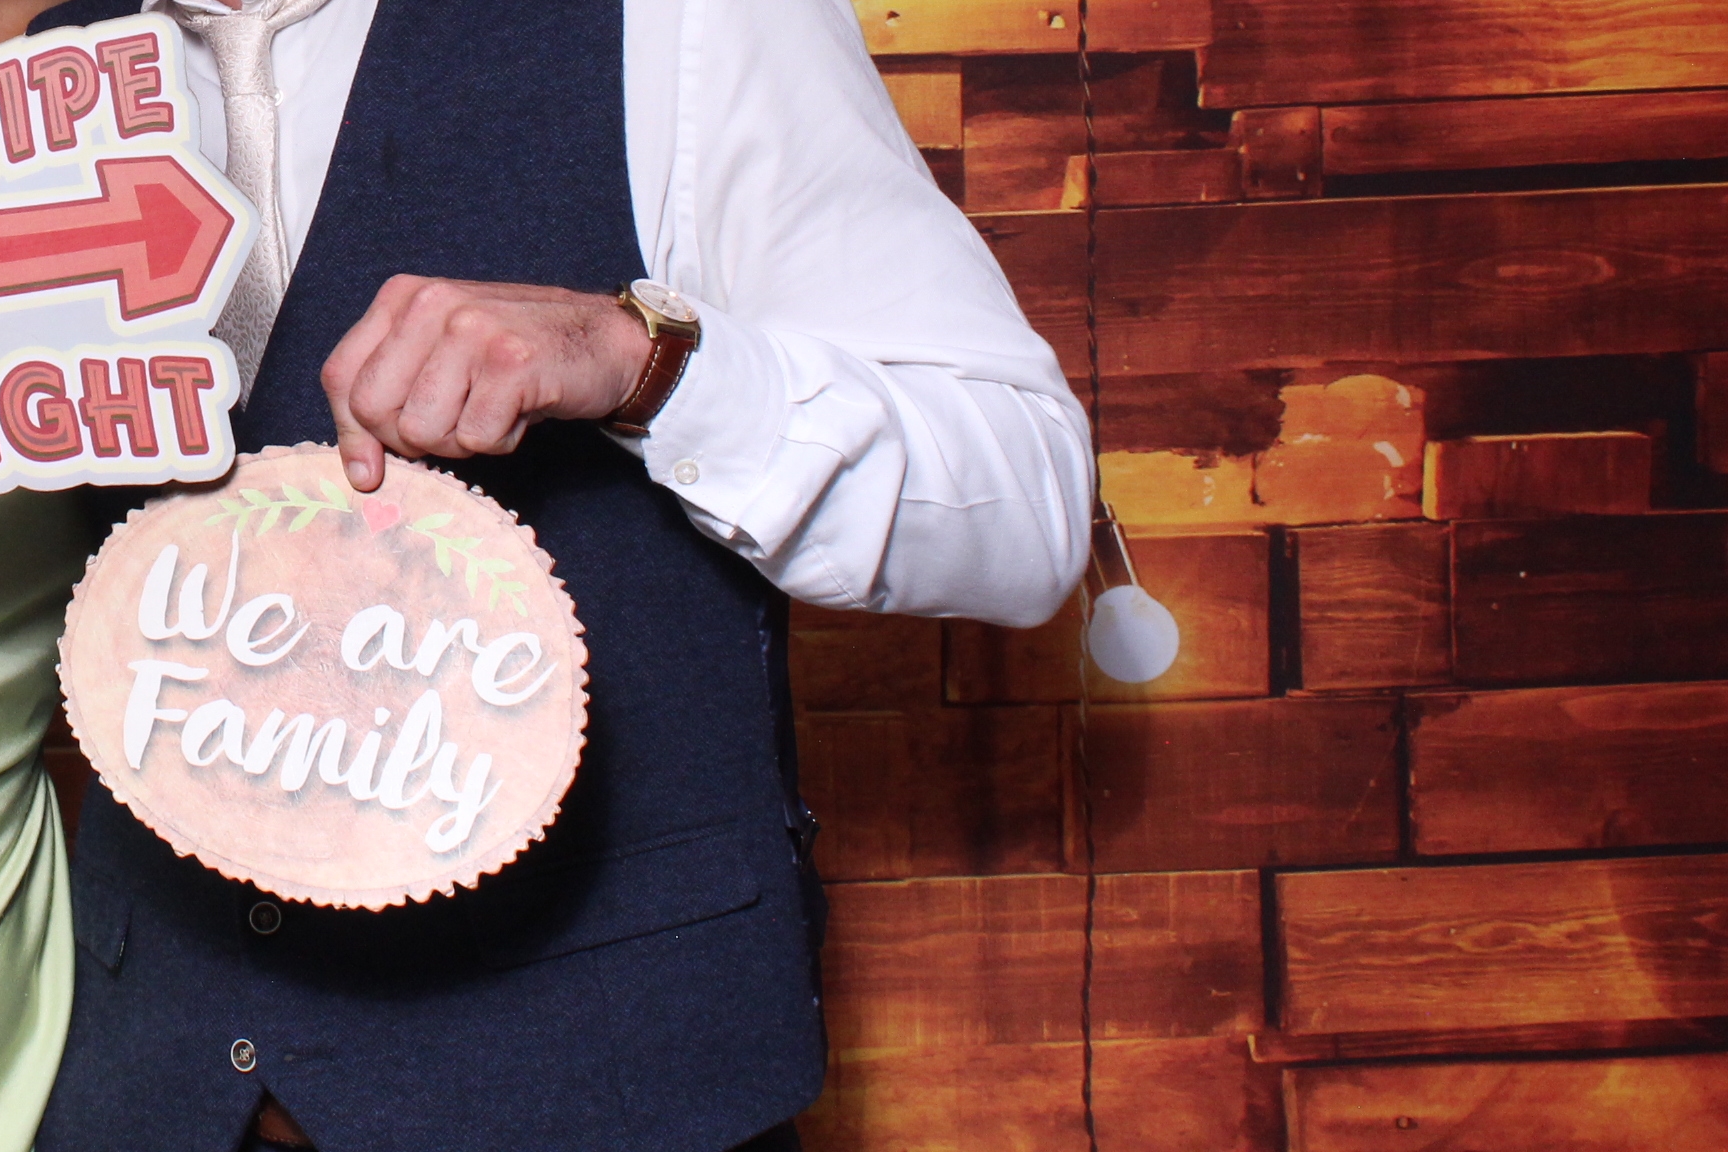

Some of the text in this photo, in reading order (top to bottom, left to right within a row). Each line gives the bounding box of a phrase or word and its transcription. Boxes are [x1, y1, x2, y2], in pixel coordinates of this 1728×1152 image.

[138, 528, 559, 706] We are
[123, 659, 503, 853] Family
